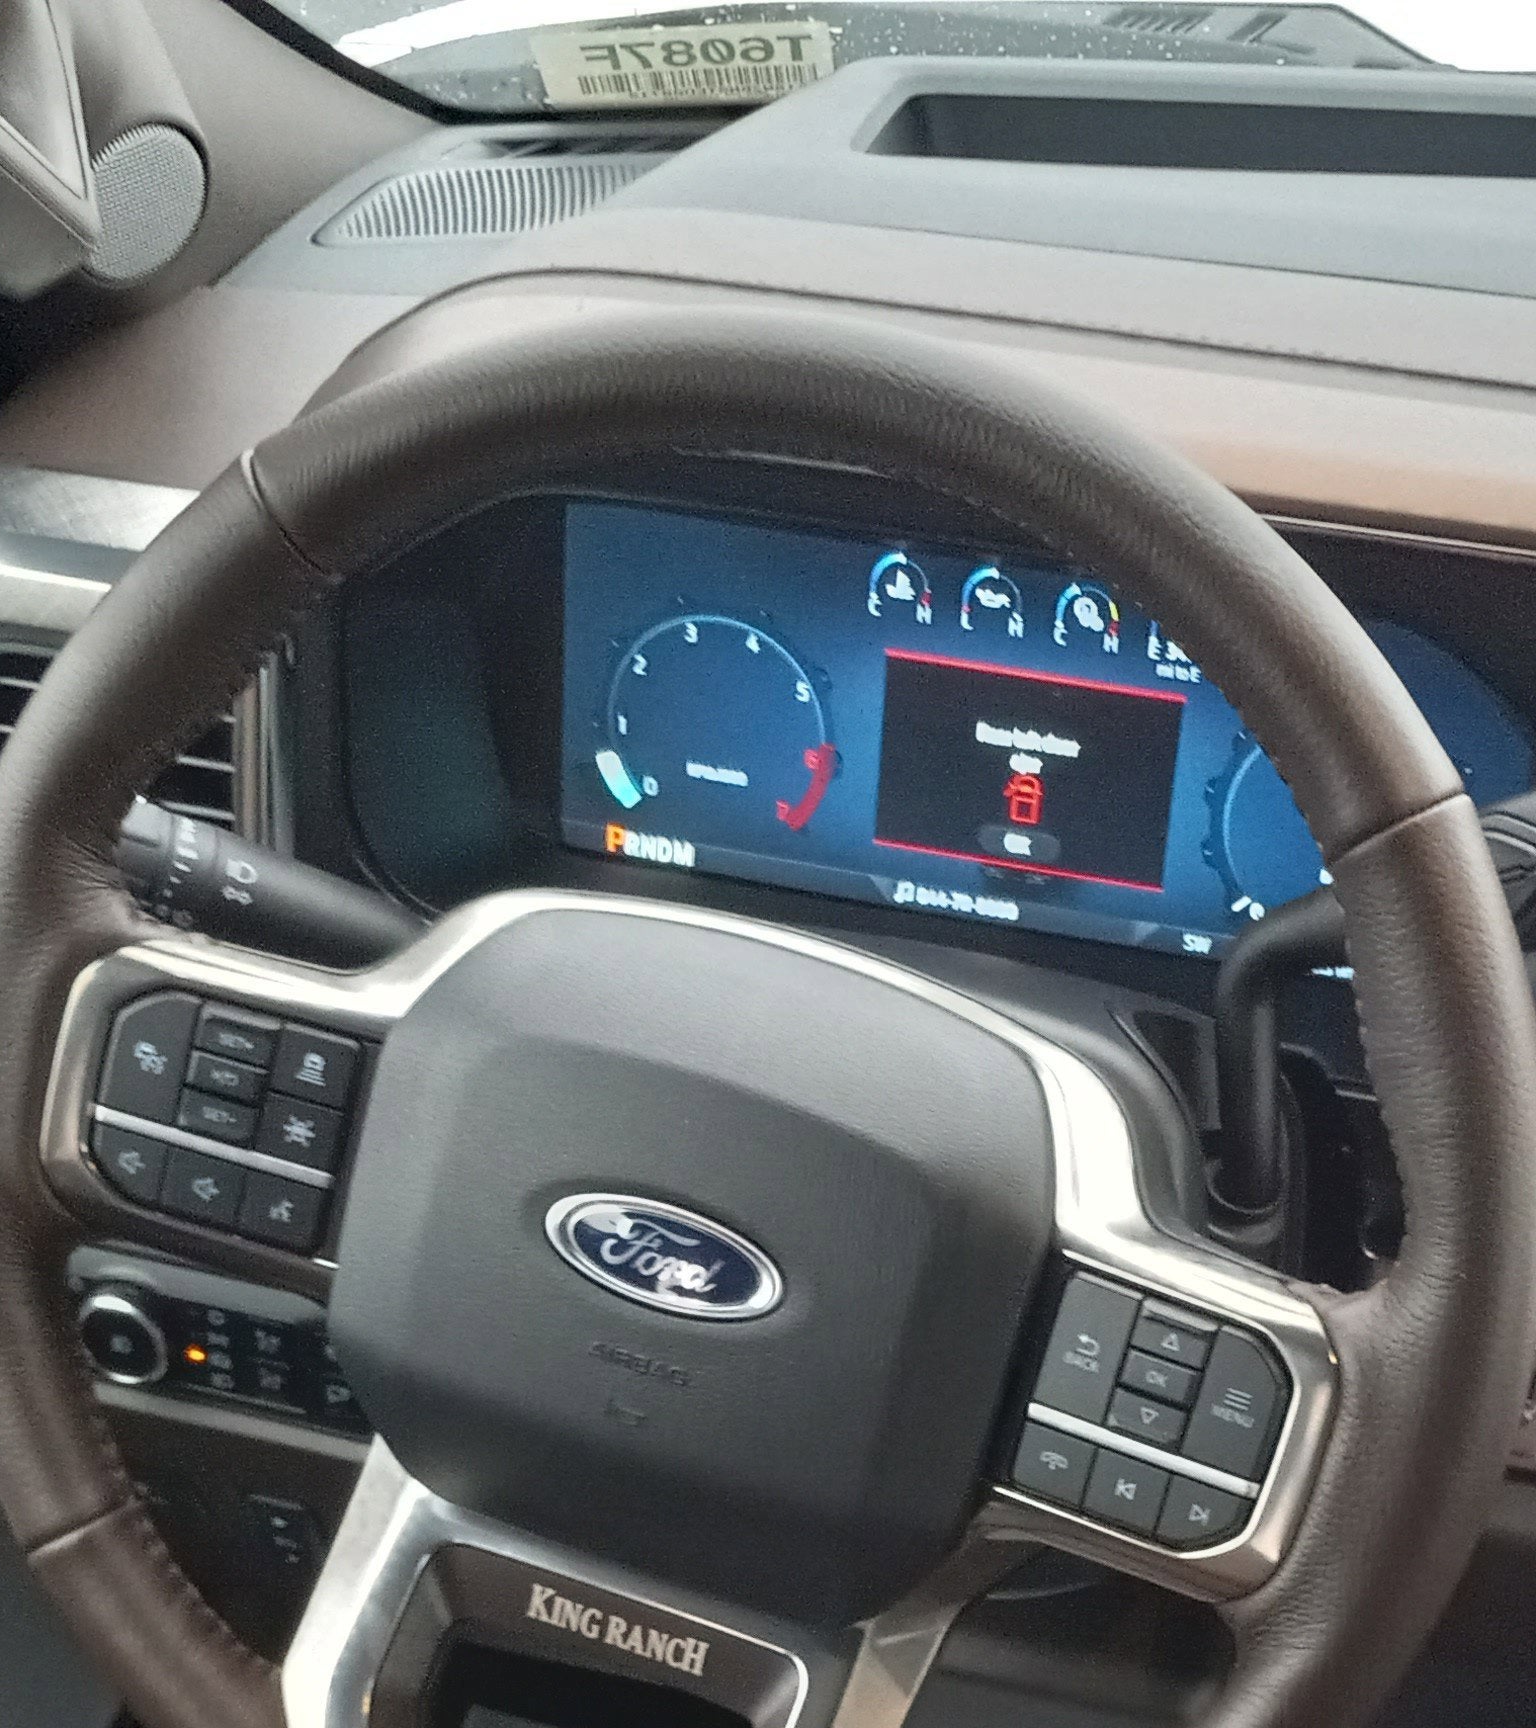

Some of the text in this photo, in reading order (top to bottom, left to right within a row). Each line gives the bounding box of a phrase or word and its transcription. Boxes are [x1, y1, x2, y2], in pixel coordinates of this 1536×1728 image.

[683, 622, 699, 644] 3
[745, 631, 760, 653] 4
[632, 654, 648, 676] 2
[796, 681, 810, 703] 5
[618, 714, 628, 736] 1
[600, 1216, 727, 1295] Ford
[526, 1583, 710, 1677] KING RANCH
